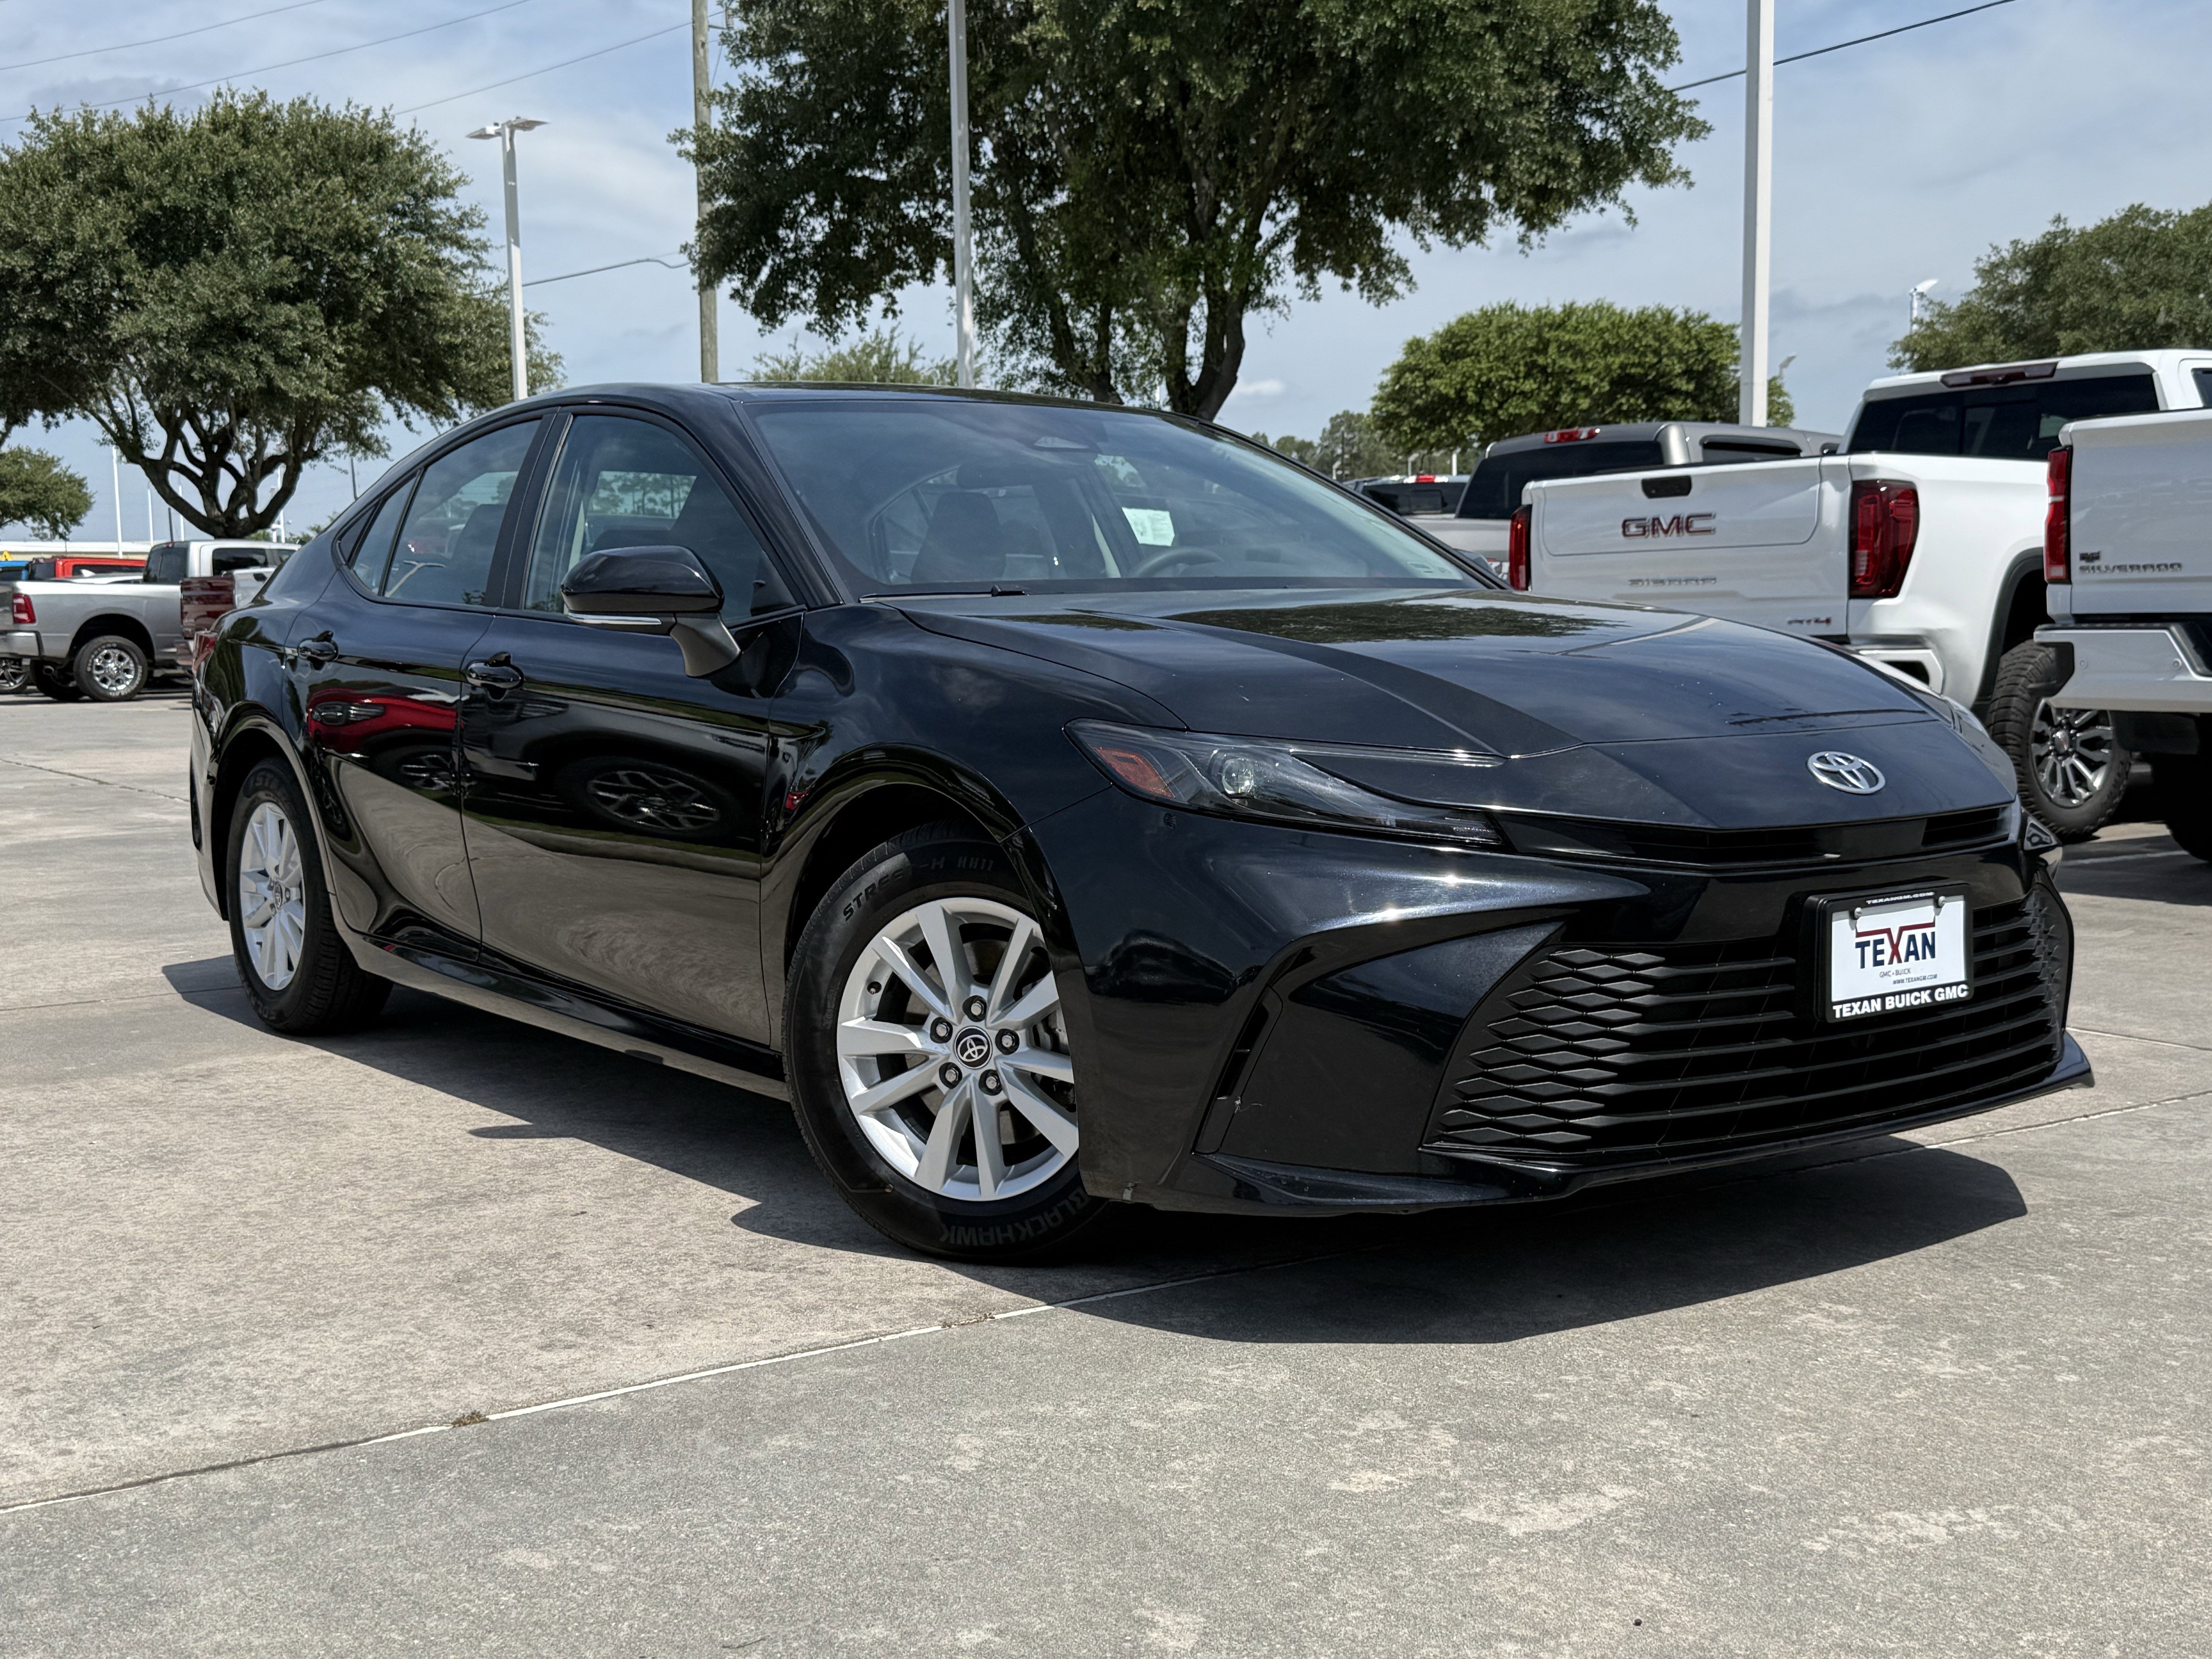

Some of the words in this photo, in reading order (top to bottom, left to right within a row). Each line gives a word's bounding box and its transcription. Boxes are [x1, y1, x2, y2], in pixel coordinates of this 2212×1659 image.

[1621, 512, 1716, 539] GMC
[1855, 927, 1936, 969] TEXAN
[1832, 998, 1882, 1018] TEXAN
[1885, 989, 1932, 1010] BUICK
[1934, 984, 1969, 1001] GMC
[939, 1185, 1093, 1246] BLACKHAWK
